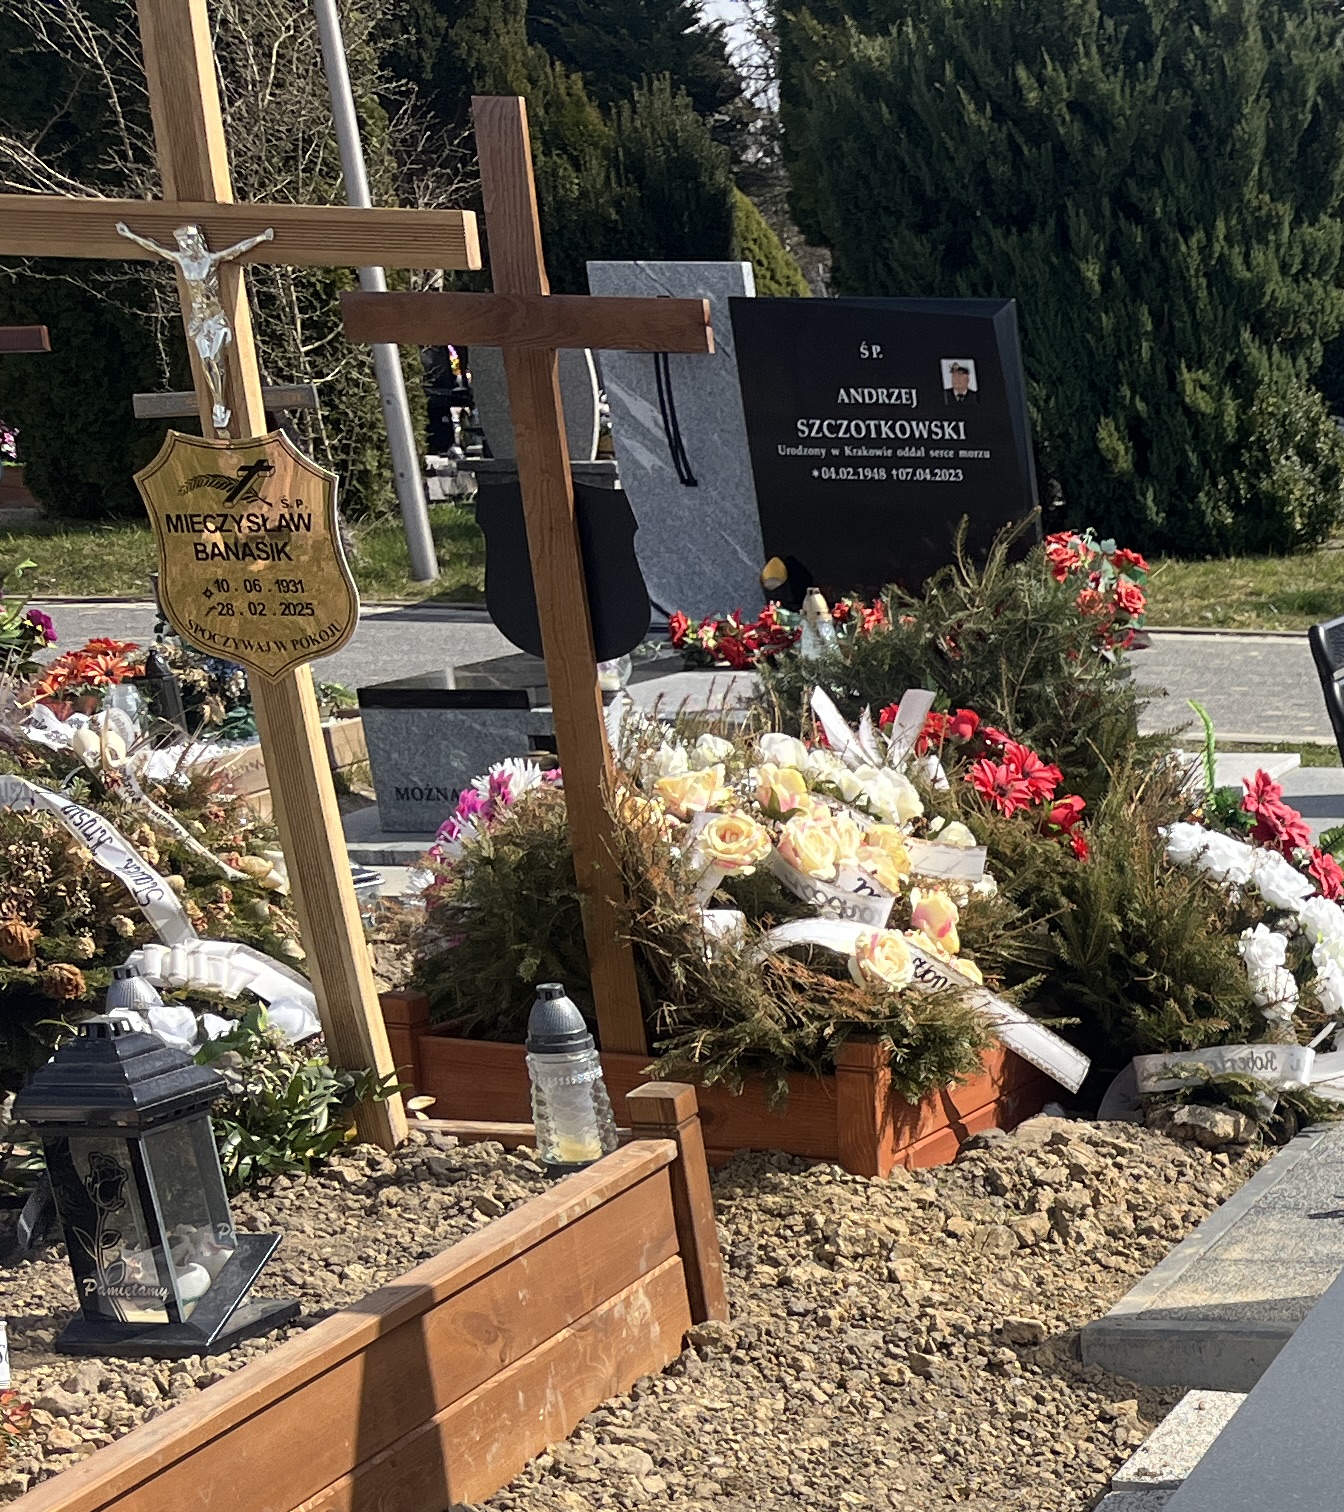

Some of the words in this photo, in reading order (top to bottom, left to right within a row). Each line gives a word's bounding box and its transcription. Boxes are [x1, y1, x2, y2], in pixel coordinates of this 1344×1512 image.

[837, 388, 918, 408] ANDRZEJ
[796, 419, 967, 440] SZCZOTKOWSKI
[777, 445, 826, 459] Urodzony
[831, 449, 840, 457] w
[844, 446, 893, 457] Krakowie
[929, 450, 954, 458] serce
[959, 450, 991, 459] morzu
[165, 513, 312, 534] MIECZYSŁAW
[194, 541, 293, 562] BANASIK
[186, 619, 271, 653] SPOCZYWAJ
[271, 641, 287, 653] W
[291, 619, 343, 650] POKOJU
[82, 1278, 170, 1301] Pamiętamy
